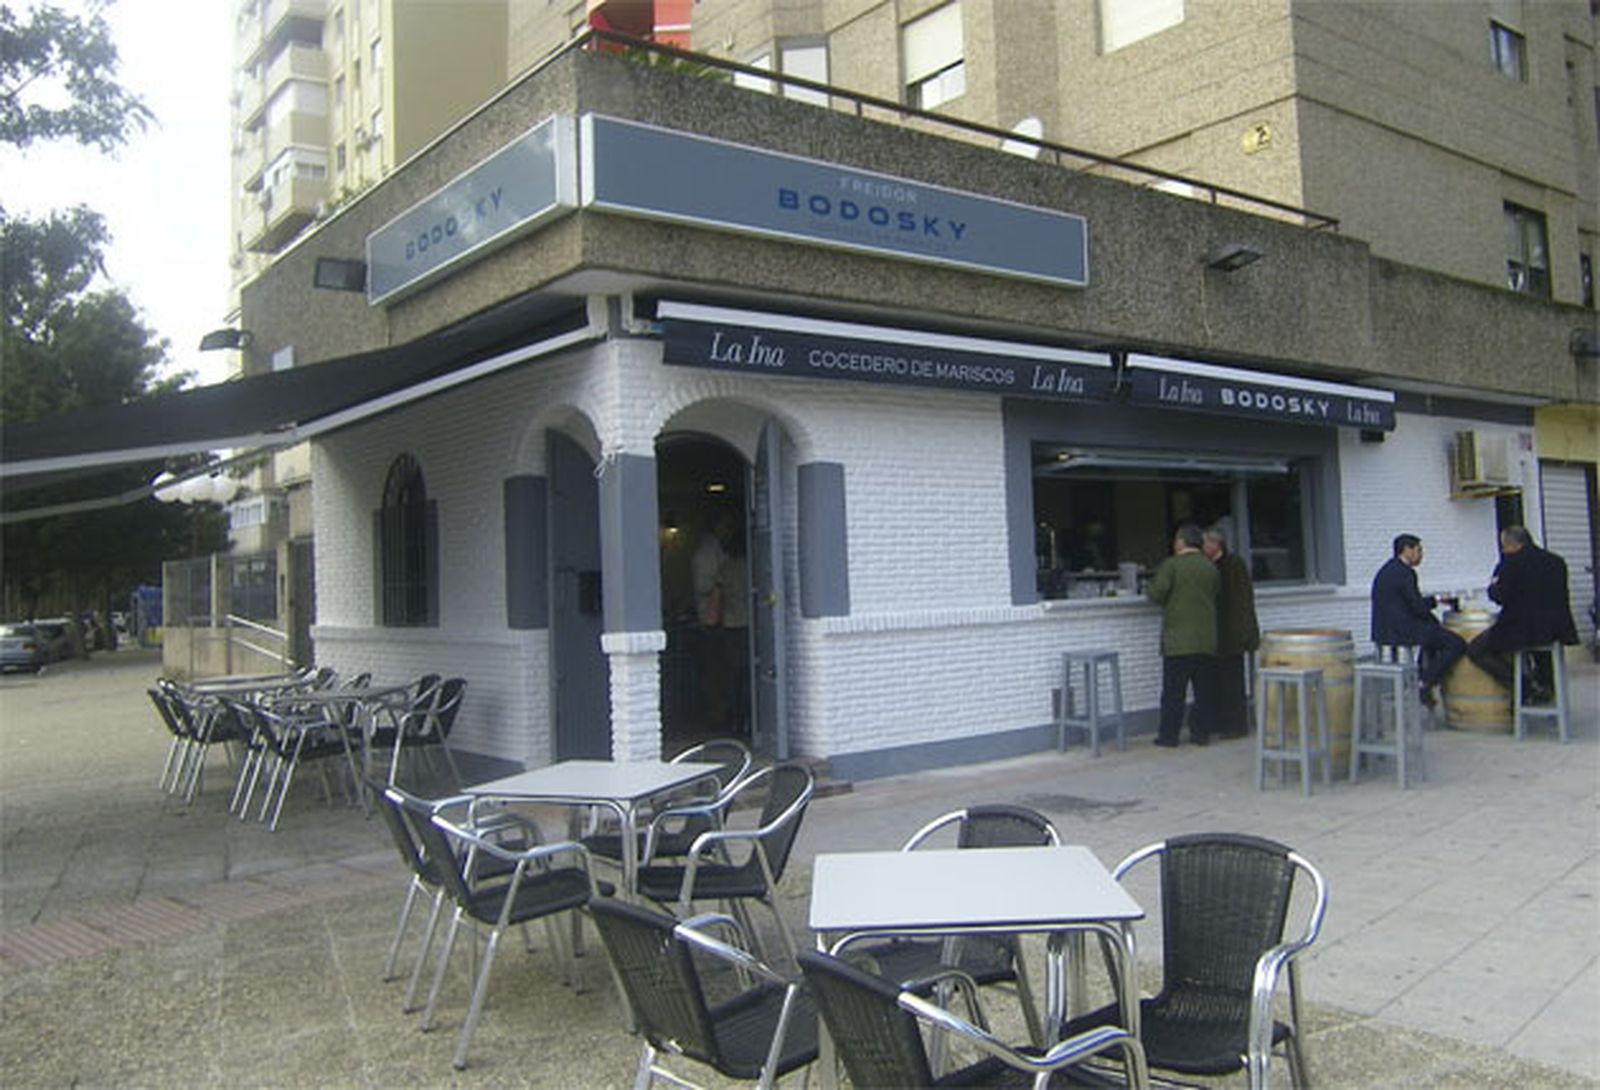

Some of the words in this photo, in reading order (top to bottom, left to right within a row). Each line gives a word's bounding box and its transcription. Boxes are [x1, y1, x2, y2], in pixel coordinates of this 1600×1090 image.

[778, 188, 967, 241] BODOSKY
[710, 332, 742, 363] La
[747, 334, 787, 367] Ina
[808, 350, 909, 375] COCEDERO
[911, 360, 934, 377] DE
[935, 362, 1016, 385] MARISCOS
[1031, 365, 1056, 391] La
[1056, 368, 1085, 394] Ina
[1159, 377, 1180, 401] La
[1220, 387, 1330, 418] BODOSKY
